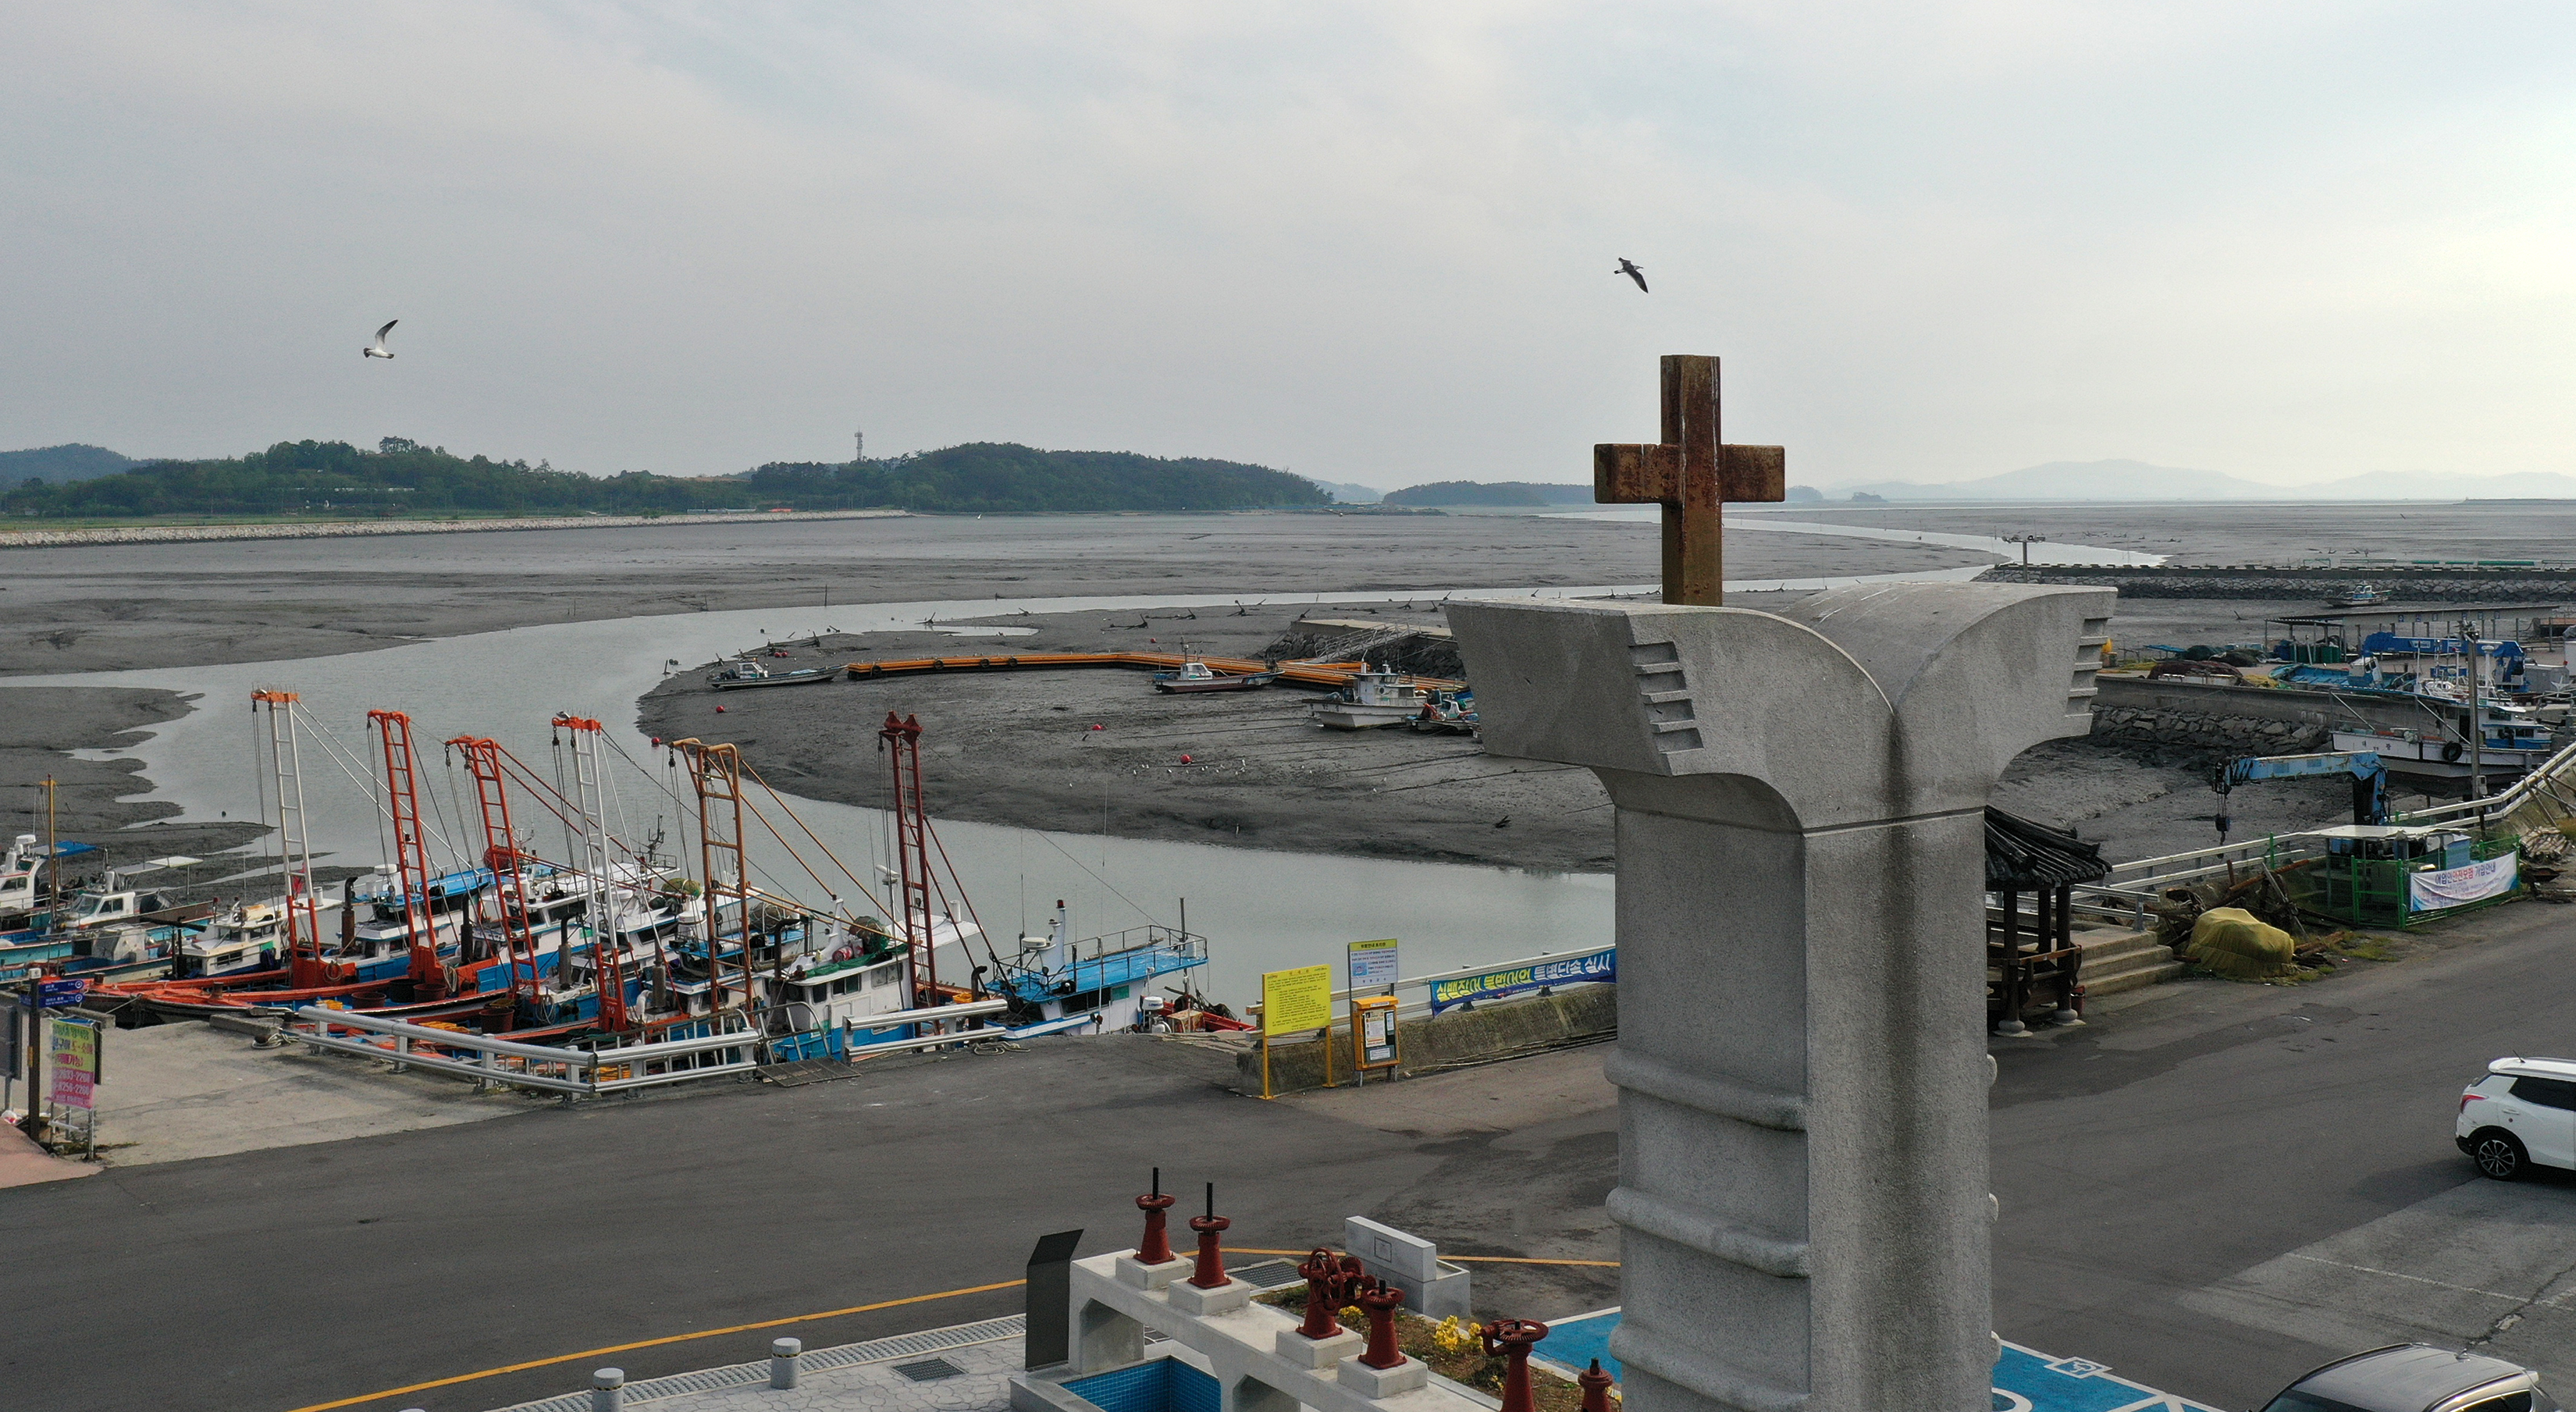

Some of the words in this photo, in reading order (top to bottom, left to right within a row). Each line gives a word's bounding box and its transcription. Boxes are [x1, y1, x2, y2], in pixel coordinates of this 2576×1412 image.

[2435, 867, 2474, 884] 어업인안전보험
[2475, 862, 2496, 877] 가입안내
[1437, 981, 1482, 1002] 실뱀장어
[1534, 962, 1585, 981] 특별단속
[1584, 954, 1611, 974] 실시
